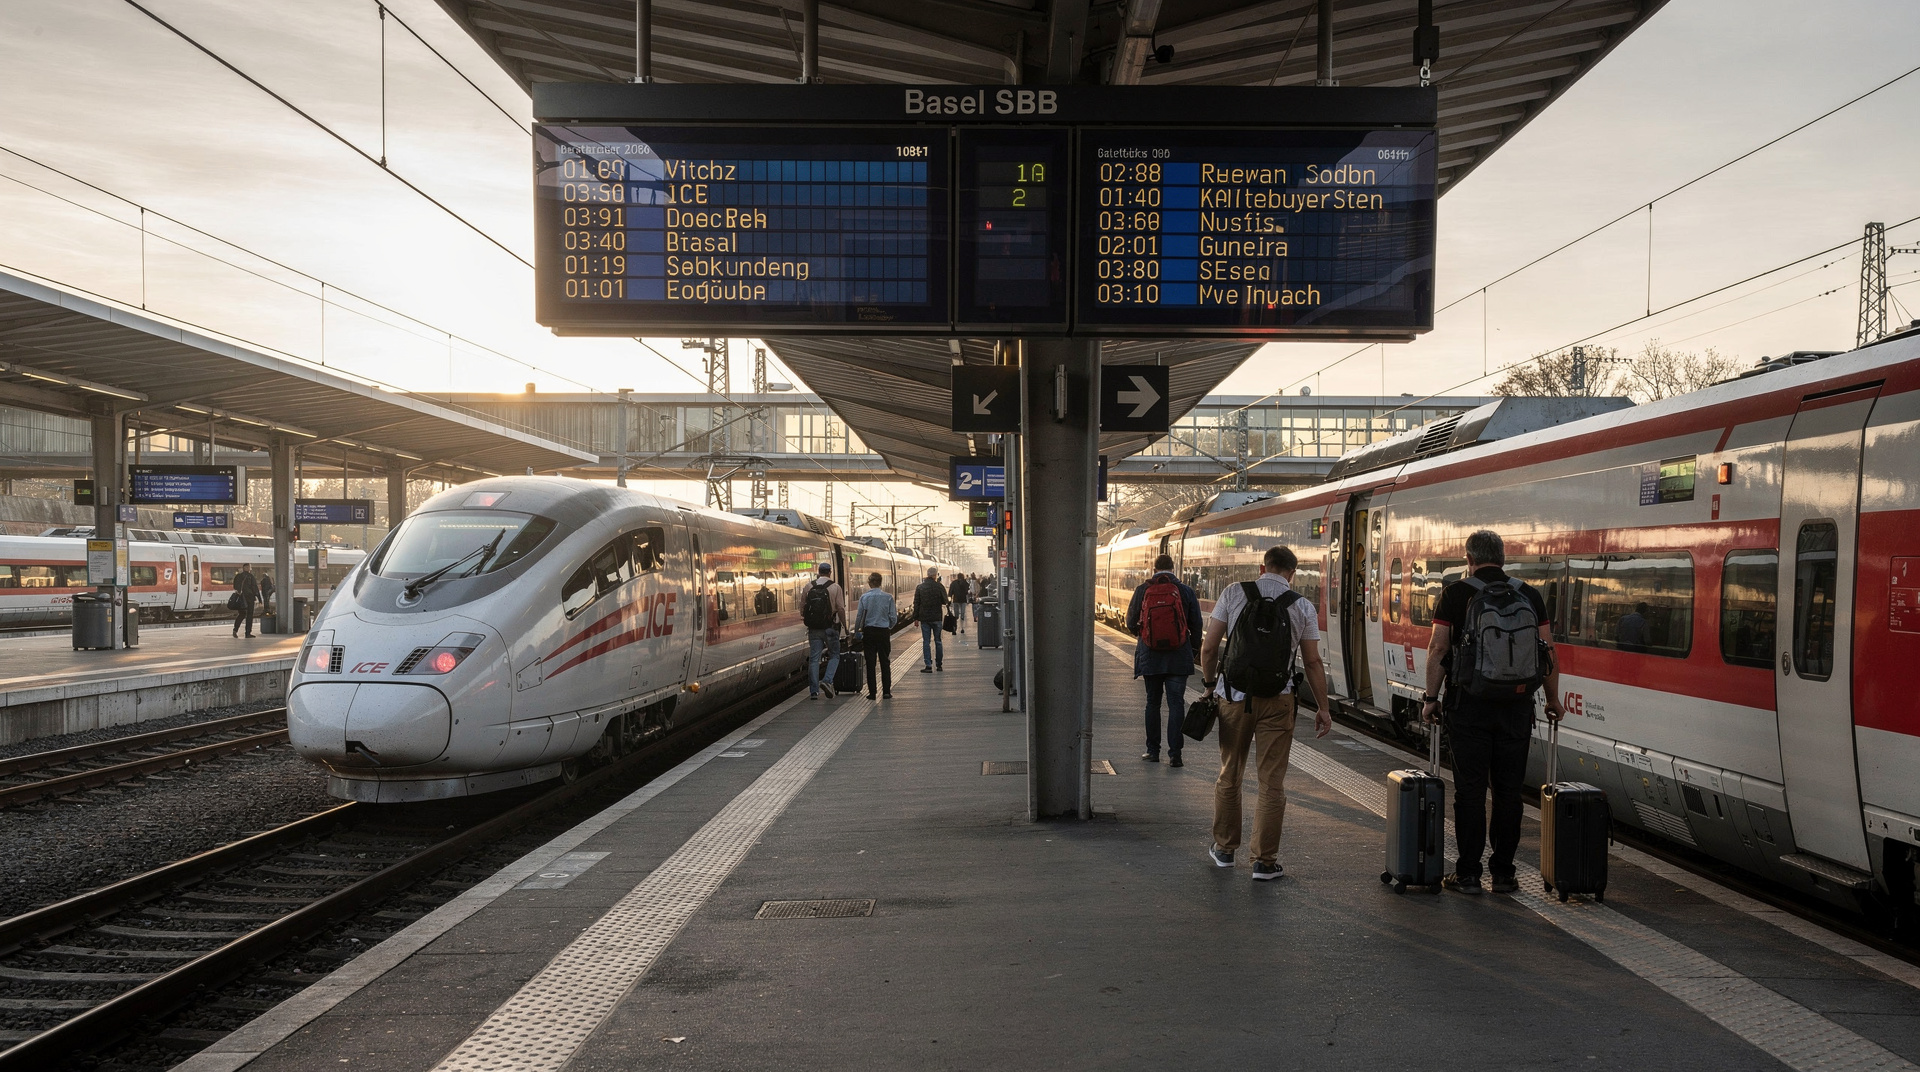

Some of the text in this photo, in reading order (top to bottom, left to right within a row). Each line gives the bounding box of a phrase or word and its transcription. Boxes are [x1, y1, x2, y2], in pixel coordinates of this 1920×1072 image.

[905, 89, 1058, 115] Basel SBB
[1100, 162, 1161, 182] 02:88
[1012, 188, 1026, 207] 2
[1100, 187, 1161, 207] 01:40
[564, 207, 625, 227] 03:91
[564, 231, 626, 251] 03:40
[1098, 235, 1159, 256] 02:01
[565, 254, 626, 275] 01:19
[1098, 259, 1160, 280] 03:80
[565, 278, 624, 299] 01:01
[1097, 283, 1159, 304] 03:10
[646, 593, 677, 639] ICE
[350, 662, 390, 674] ICE
[1563, 691, 1583, 716] ICE
